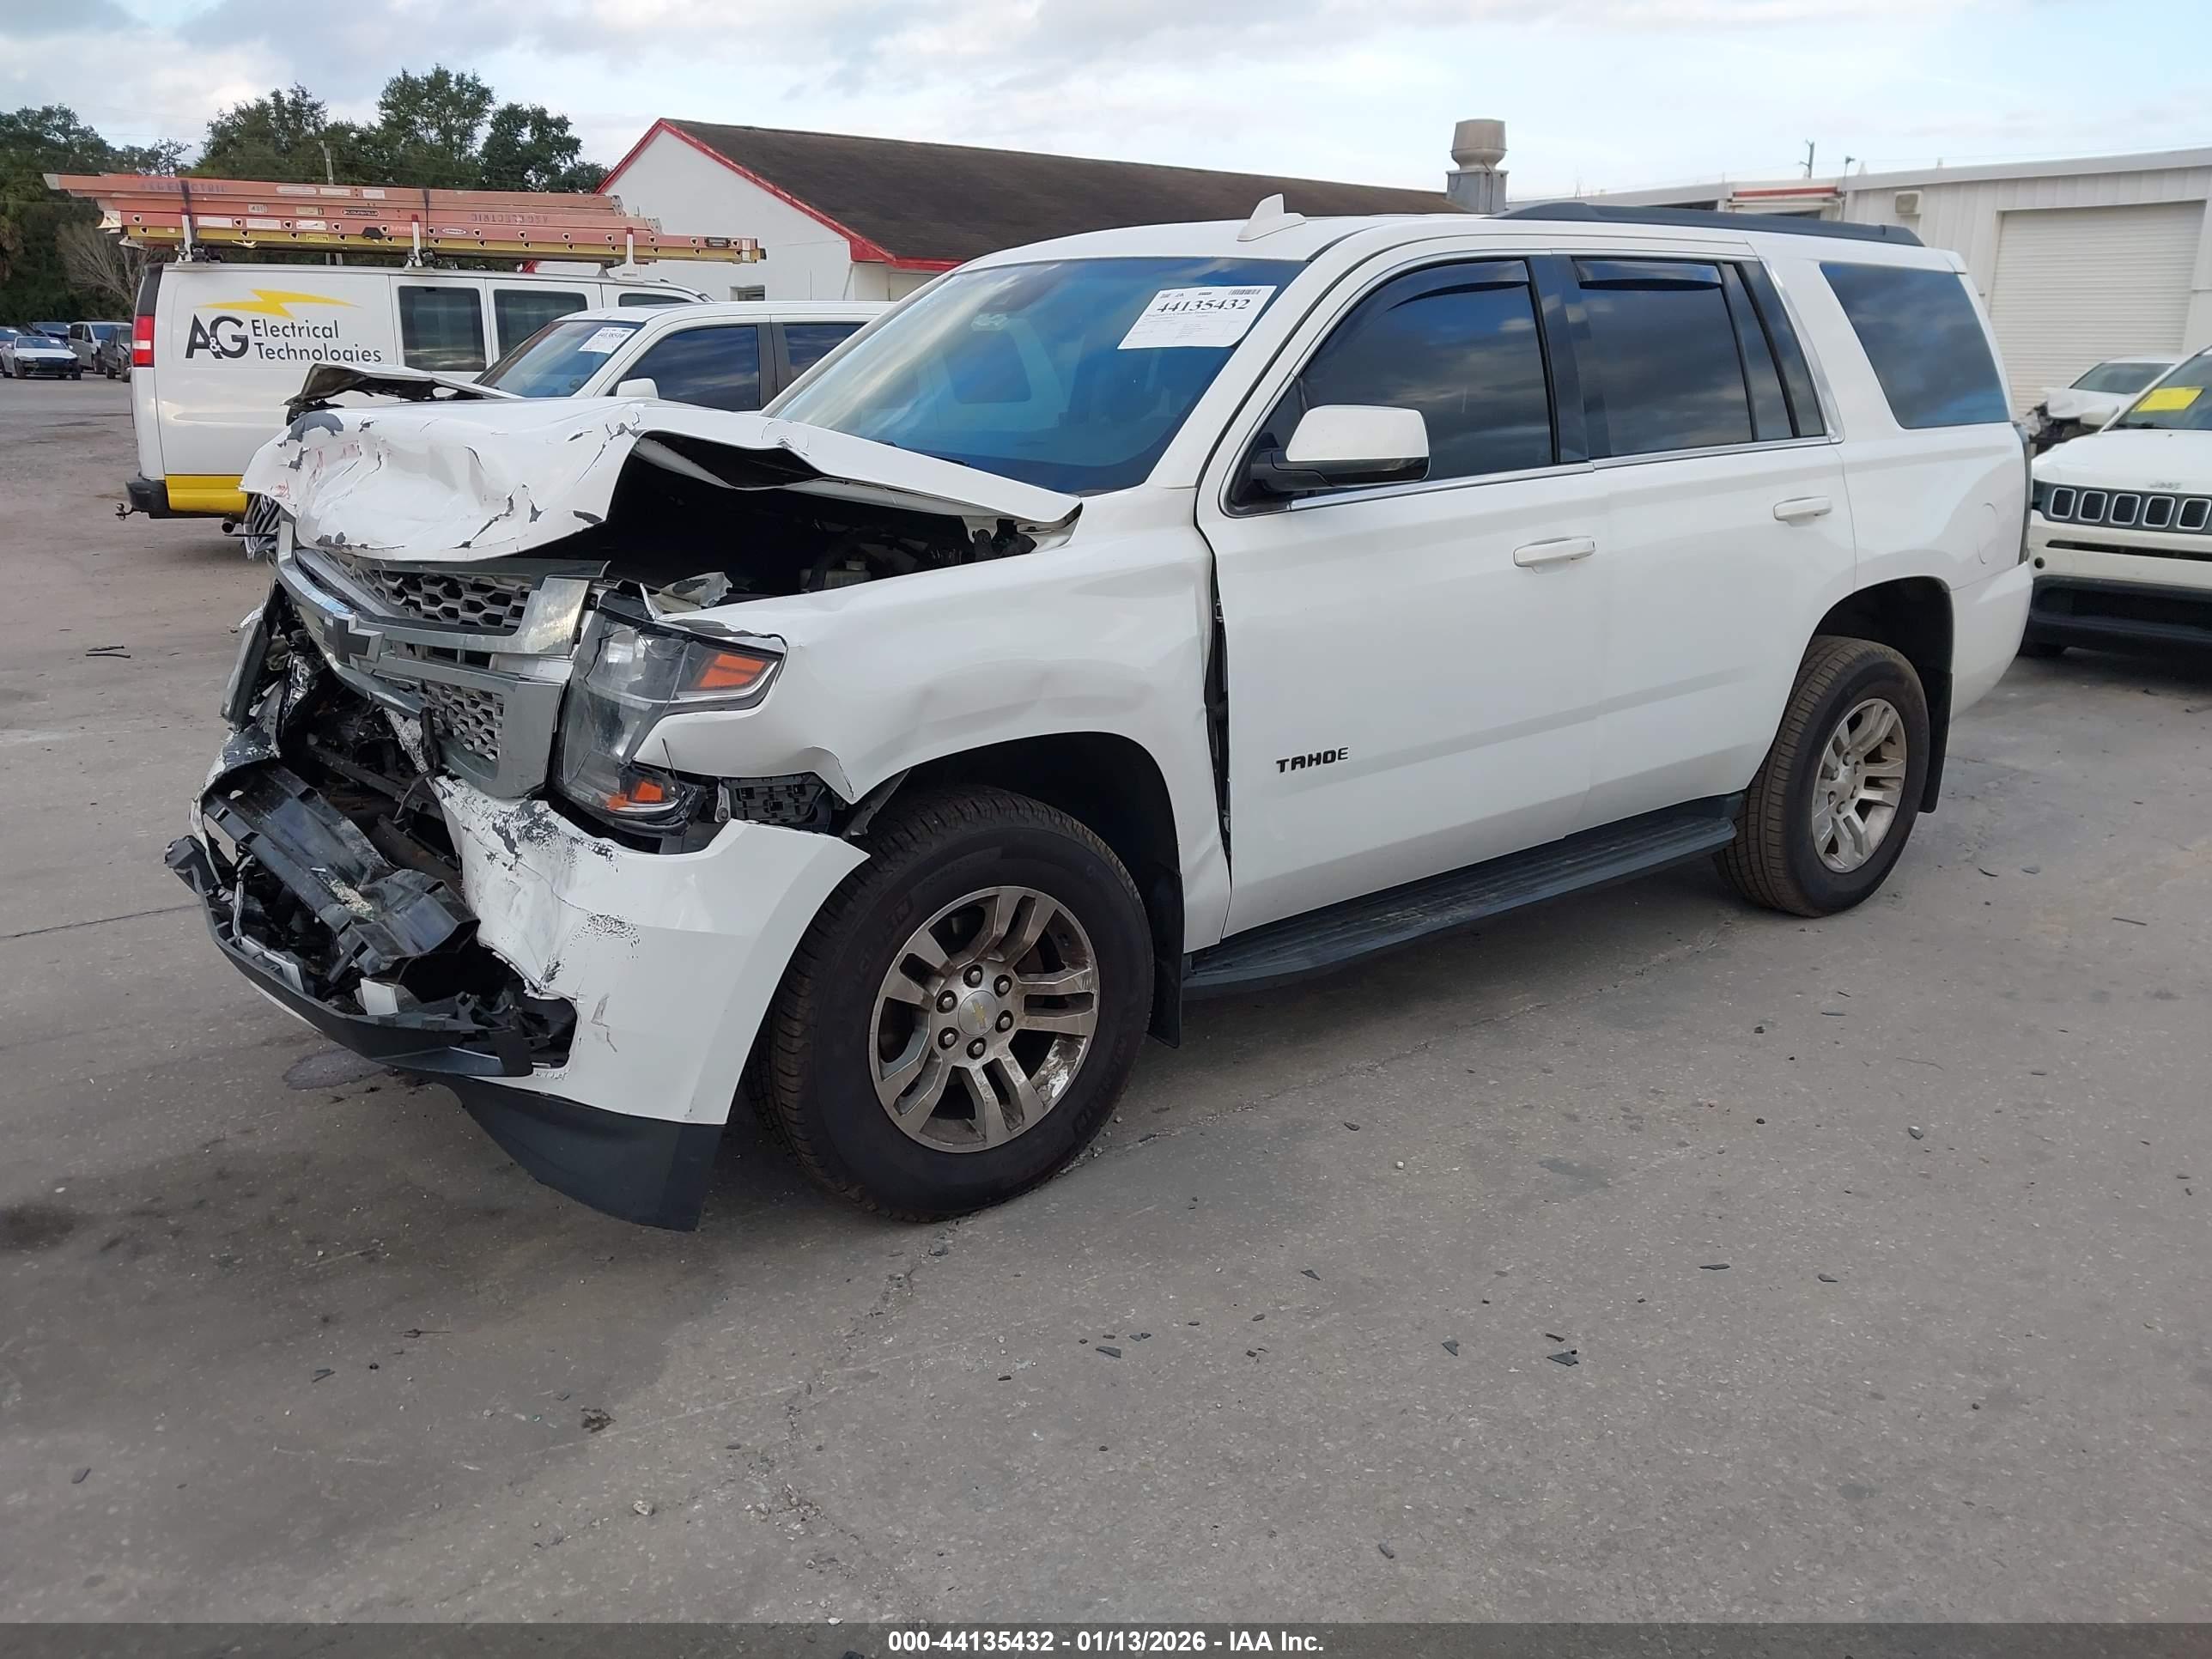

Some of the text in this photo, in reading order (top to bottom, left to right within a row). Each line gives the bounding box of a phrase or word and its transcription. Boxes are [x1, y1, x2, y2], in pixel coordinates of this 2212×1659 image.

[1157, 299, 1251, 313] 44135432
[185, 313, 339, 359] A&G Electrical
[254, 342, 382, 363] Technologies
[1276, 747, 1349, 774] TAHOE
